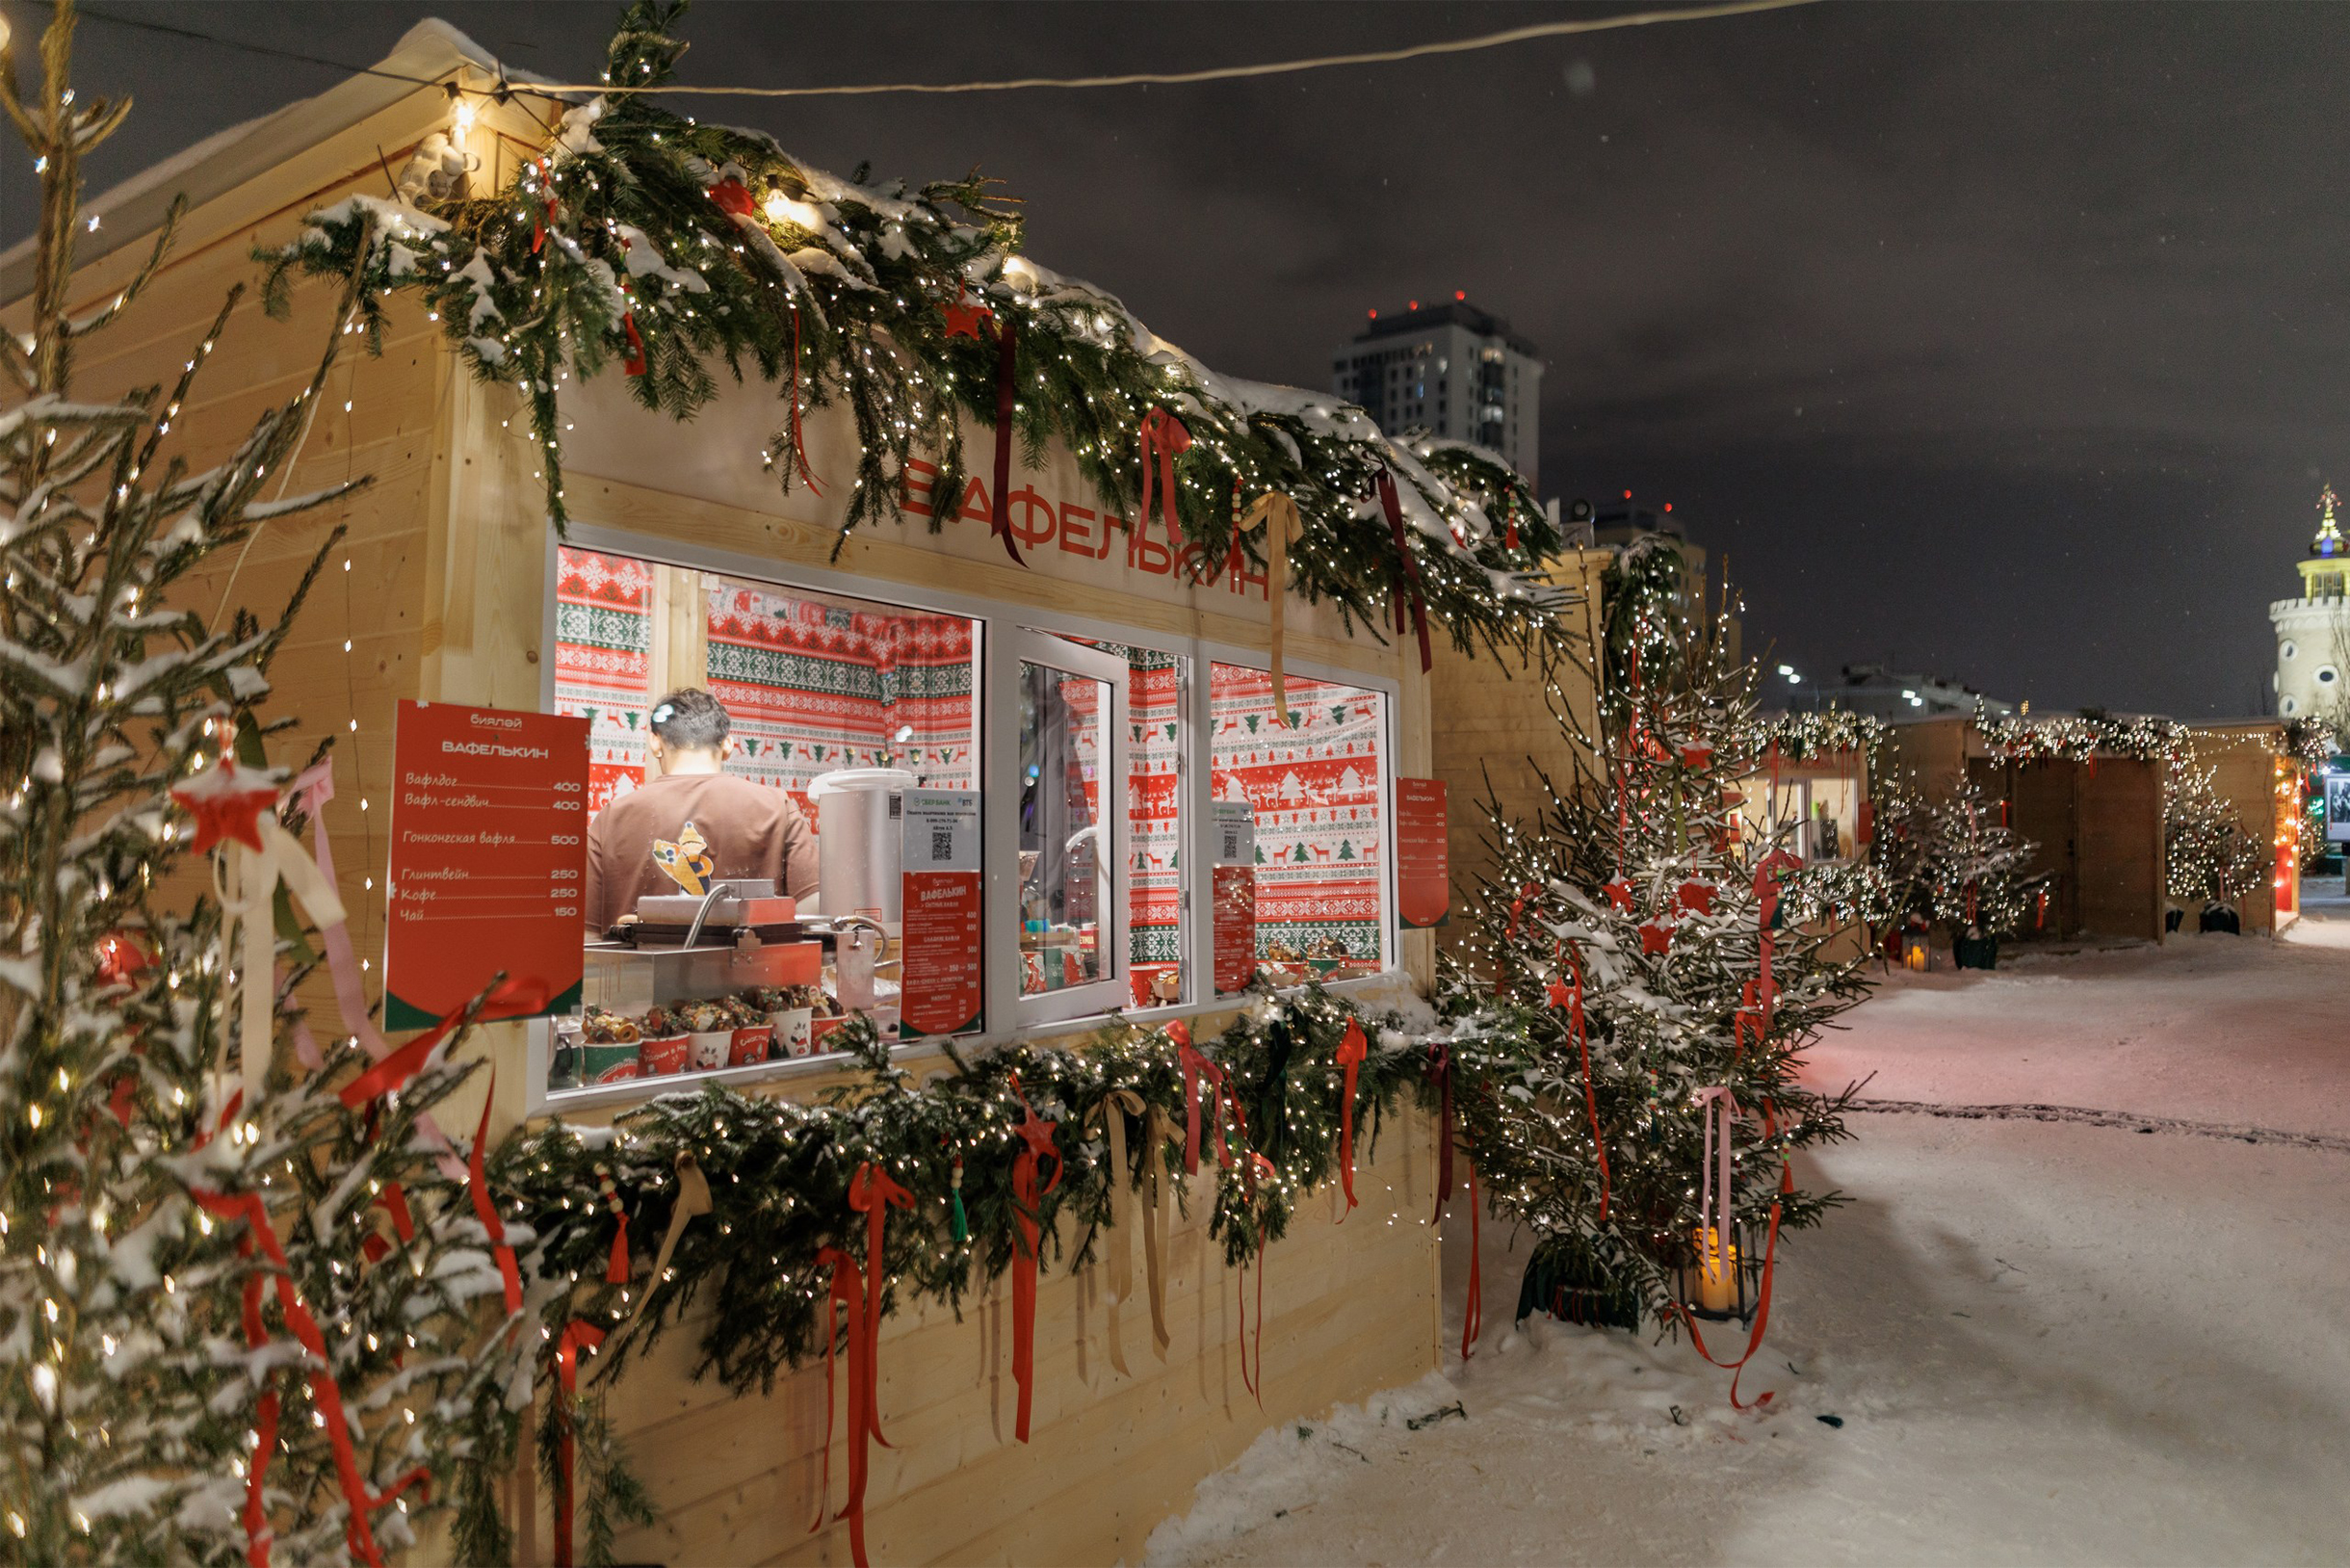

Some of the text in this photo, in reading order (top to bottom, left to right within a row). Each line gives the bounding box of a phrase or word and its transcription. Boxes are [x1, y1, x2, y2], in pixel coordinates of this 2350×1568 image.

[442, 741, 549, 759] ВАФЕЛЬКИН
[405, 772, 581, 793] Вафлдог 400
[552, 800, 580, 811] 400
[403, 830, 579, 848] Гонконгская вафля 500
[401, 868, 578, 882] Глинтвейн 250
[401, 888, 578, 903] Кофе 250
[920, 885, 967, 902] ВАФЕЛЬКИН
[400, 906, 577, 922] Чай 150
